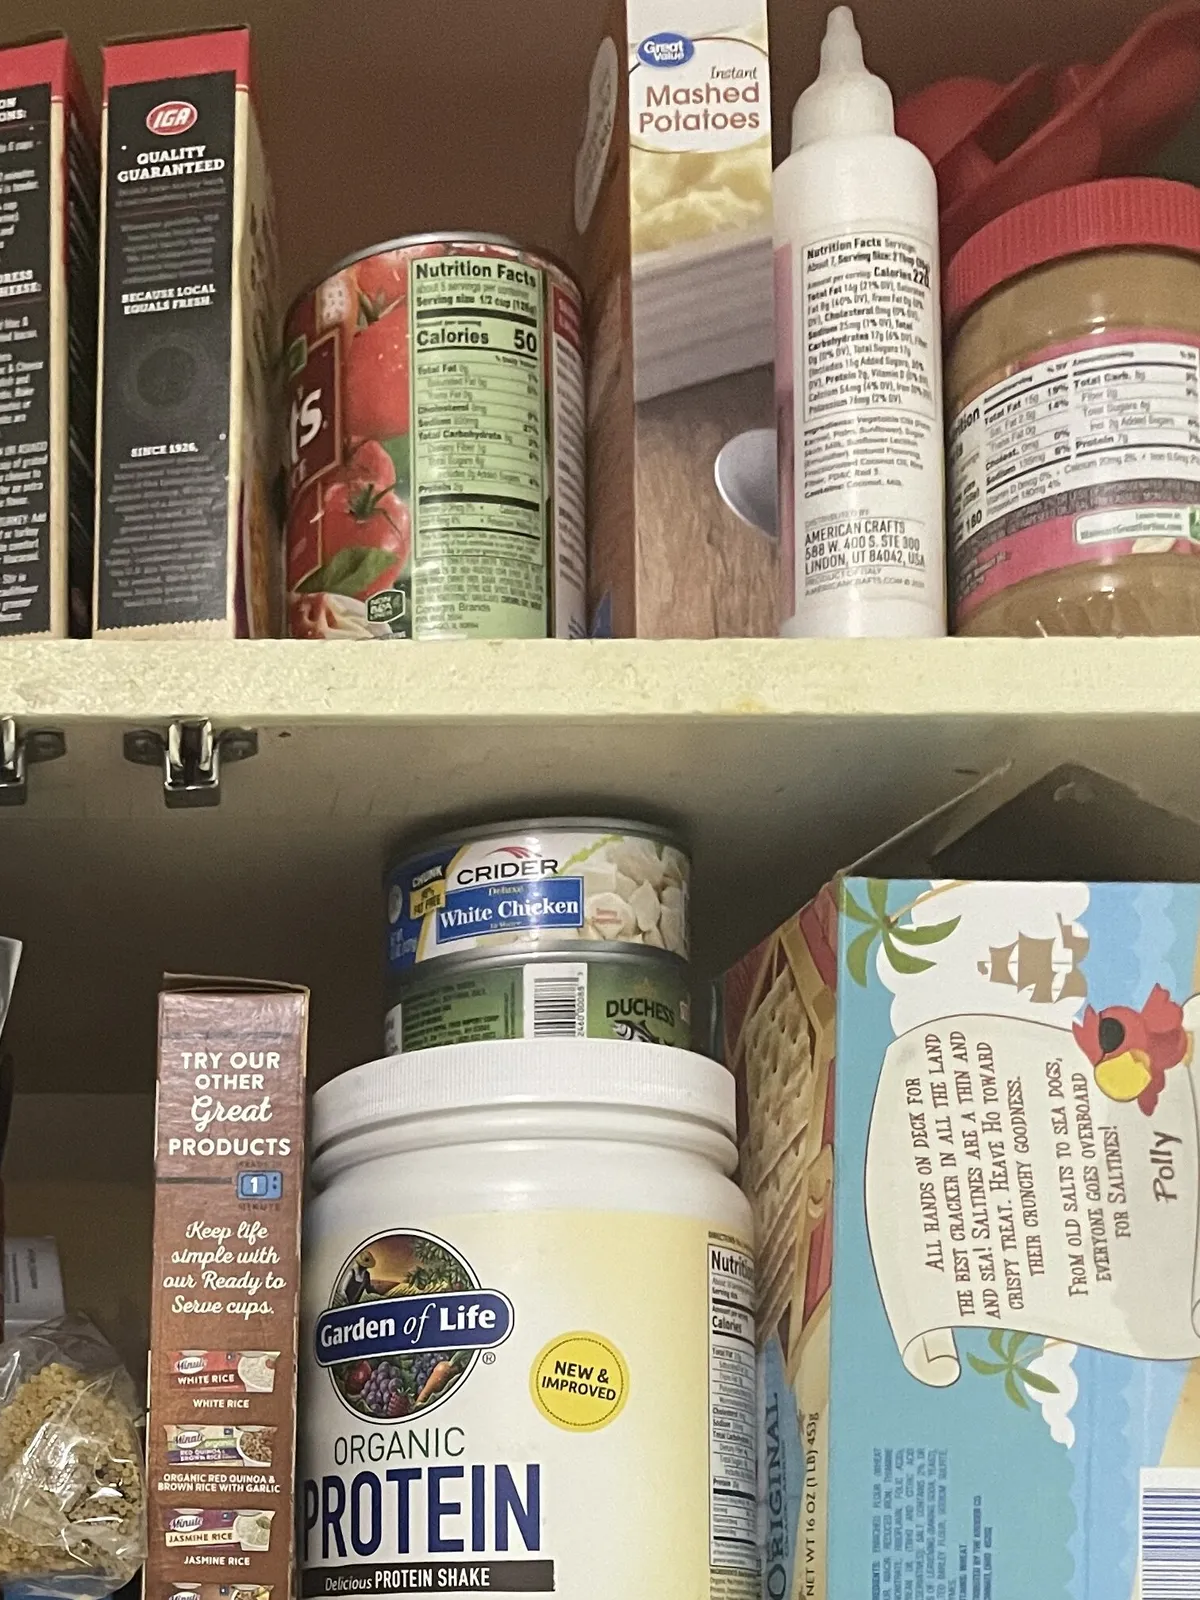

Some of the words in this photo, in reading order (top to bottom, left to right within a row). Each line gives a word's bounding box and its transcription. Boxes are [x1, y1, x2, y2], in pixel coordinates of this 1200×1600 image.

[644, 40, 684, 54] Great
[654, 49, 685, 62] Value
[710, 65, 758, 80] Instant
[646, 82, 760, 106] Mashed
[153, 108, 189, 128] IGA
[639, 109, 760, 134] Potatoes
[136, 145, 206, 165] QUALITY
[117, 159, 225, 182] GUARANTEED
[416, 264, 492, 281] Nutrition
[497, 265, 536, 288] Facts
[417, 329, 489, 347] Calories
[514, 329, 537, 353] 50
[131, 446, 166, 457] SINCE
[805, 522, 860, 546] AMERICAN
[865, 520, 905, 533] CRAFTS
[456, 858, 558, 885] CRIDER
[440, 908, 492, 929] White
[498, 899, 579, 918] Chicken
[606, 998, 674, 1027] DUCHESS
[181, 1053, 221, 1070] TRY
[230, 1052, 280, 1069] OUR
[925, 1033, 943, 1074] LAND
[195, 1074, 265, 1090] OTHER
[906, 1078, 922, 1105] FOR
[931, 1082, 949, 1108] THE
[191, 1095, 272, 1132] Great
[1072, 1073, 1095, 1159] OVERBOARD
[910, 1113, 929, 1148] DECK
[936, 1116, 954, 1145] ALL
[169, 1138, 291, 1156] PRODUCTS
[940, 1153, 956, 1167] IN
[915, 1156, 932, 1175] ON
[1098, 1125, 1127, 1205] SALTINES!
[1149, 1131, 1183, 1204] Polly
[1083, 1166, 1101, 1201] GOES
[920, 1182, 940, 1234] HANDS
[944, 1175, 965, 1241] CRACKER
[186, 1221, 231, 1245] Keep
[237, 1221, 268, 1244] life
[1115, 1211, 1131, 1239] FOR
[172, 1246, 234, 1265] simple
[237, 1247, 279, 1264] with
[925, 1239, 944, 1272] ALL
[1087, 1208, 1112, 1282] EVERYONE
[953, 1249, 970, 1282] BEST
[163, 1274, 196, 1289] our
[202, 1270, 262, 1294] Ready
[265, 1273, 286, 1290] to
[172, 1295, 222, 1314] Serve
[226, 1299, 275, 1316] cups.
[957, 1289, 975, 1317] THE
[321, 1314, 395, 1346] Garden
[403, 1303, 438, 1343] of
[439, 1305, 496, 1331] Life
[555, 1361, 592, 1379] NEW
[597, 1368, 609, 1383] &
[540, 1377, 617, 1401] IMPROVED
[193, 1399, 225, 1408] WHITE
[227, 1398, 250, 1408] RICE
[335, 1427, 465, 1464] ORGANIC
[304, 1464, 541, 1562] PROTEIN
[184, 1556, 225, 1565] JASMINE
[228, 1556, 250, 1565] RICE
[325, 1572, 372, 1592] Delicious
[375, 1569, 434, 1589] PROTEIN
[438, 1566, 490, 1587] SHAKE
